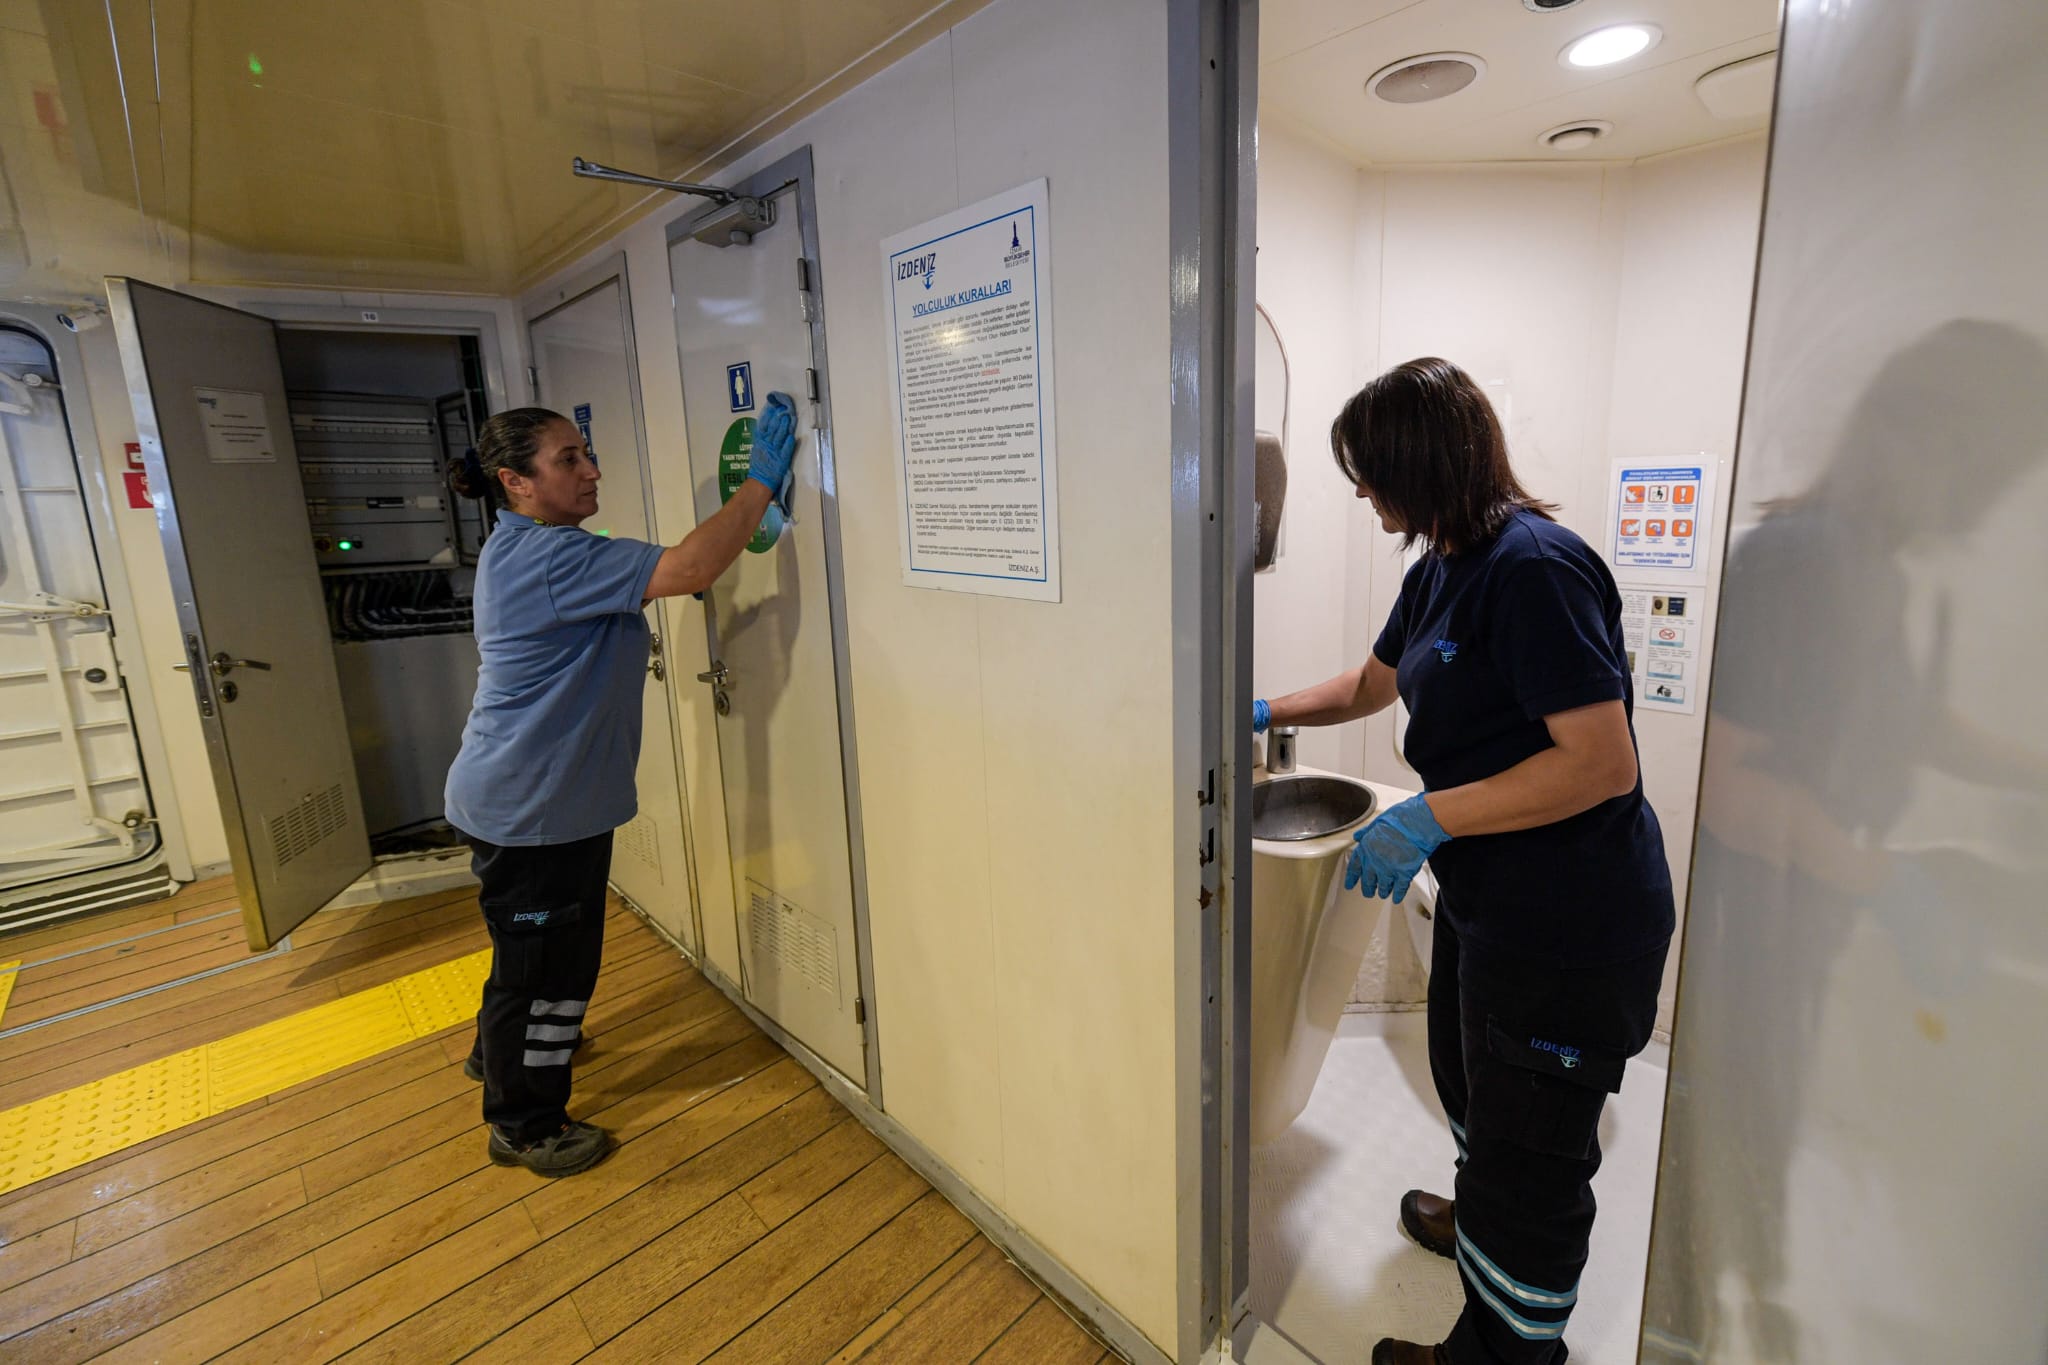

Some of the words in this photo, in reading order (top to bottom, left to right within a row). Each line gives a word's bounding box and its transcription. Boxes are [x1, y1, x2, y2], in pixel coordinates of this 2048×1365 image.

[897, 252, 936, 281] İZDENİZ
[912, 294, 956, 316] YOLCULUK
[958, 279, 1012, 303] KURALLARI
